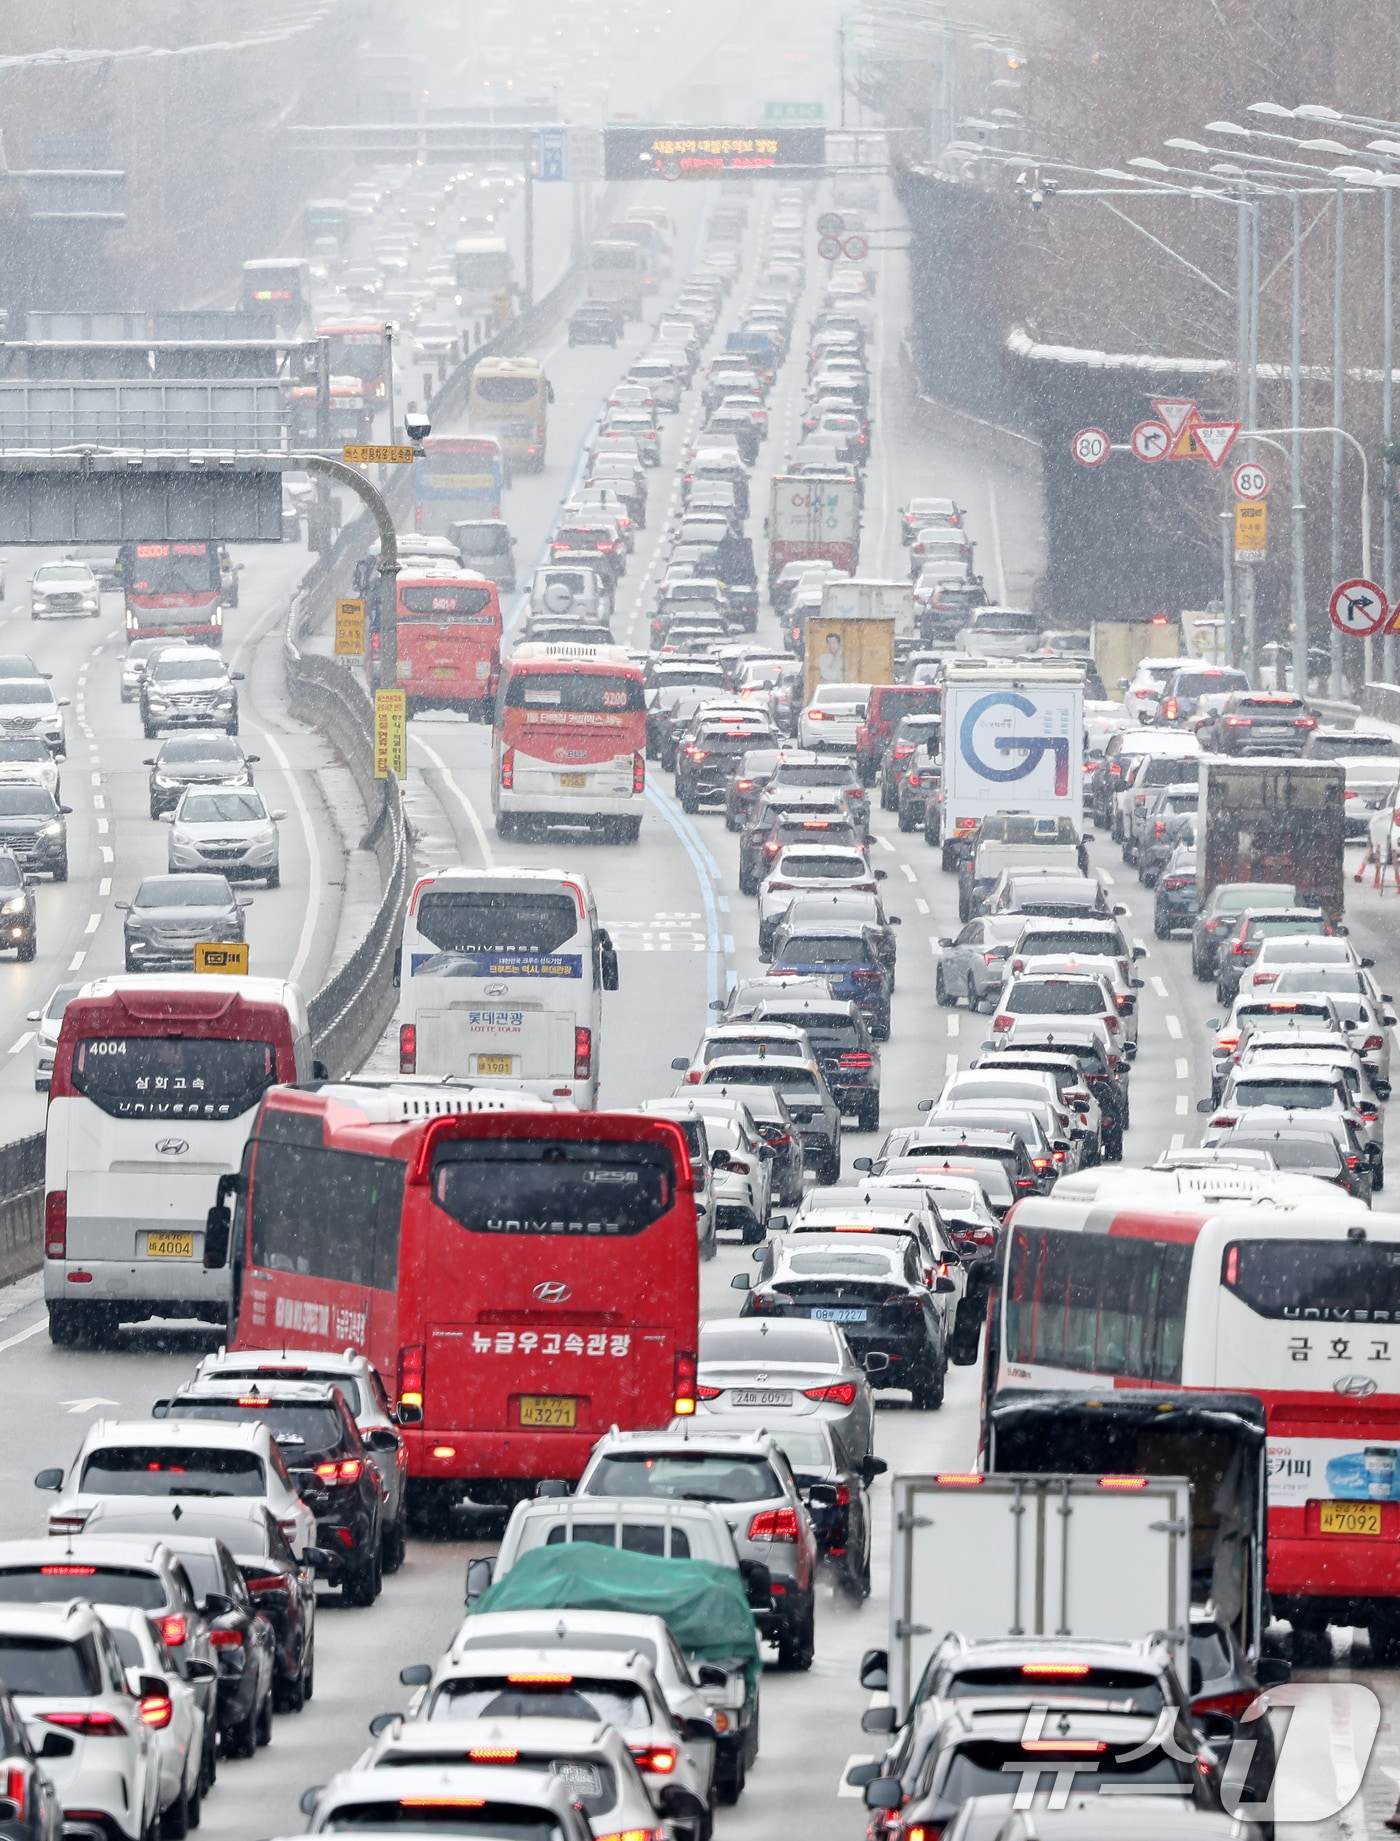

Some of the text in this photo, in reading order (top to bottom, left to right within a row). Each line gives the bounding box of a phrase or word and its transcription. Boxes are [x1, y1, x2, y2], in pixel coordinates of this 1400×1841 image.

[1079, 439, 1102, 457] 80
[1240, 474, 1264, 491] 80
[469, 1011, 524, 1026] 롯데관광
[89, 1042, 127, 1055] 4004
[135, 1077, 206, 1091] 삼화고속
[839, 1310, 863, 1319] 7227
[471, 1331, 631, 1357] 뉴금우고속관광
[761, 1394, 787, 1403] 6097
